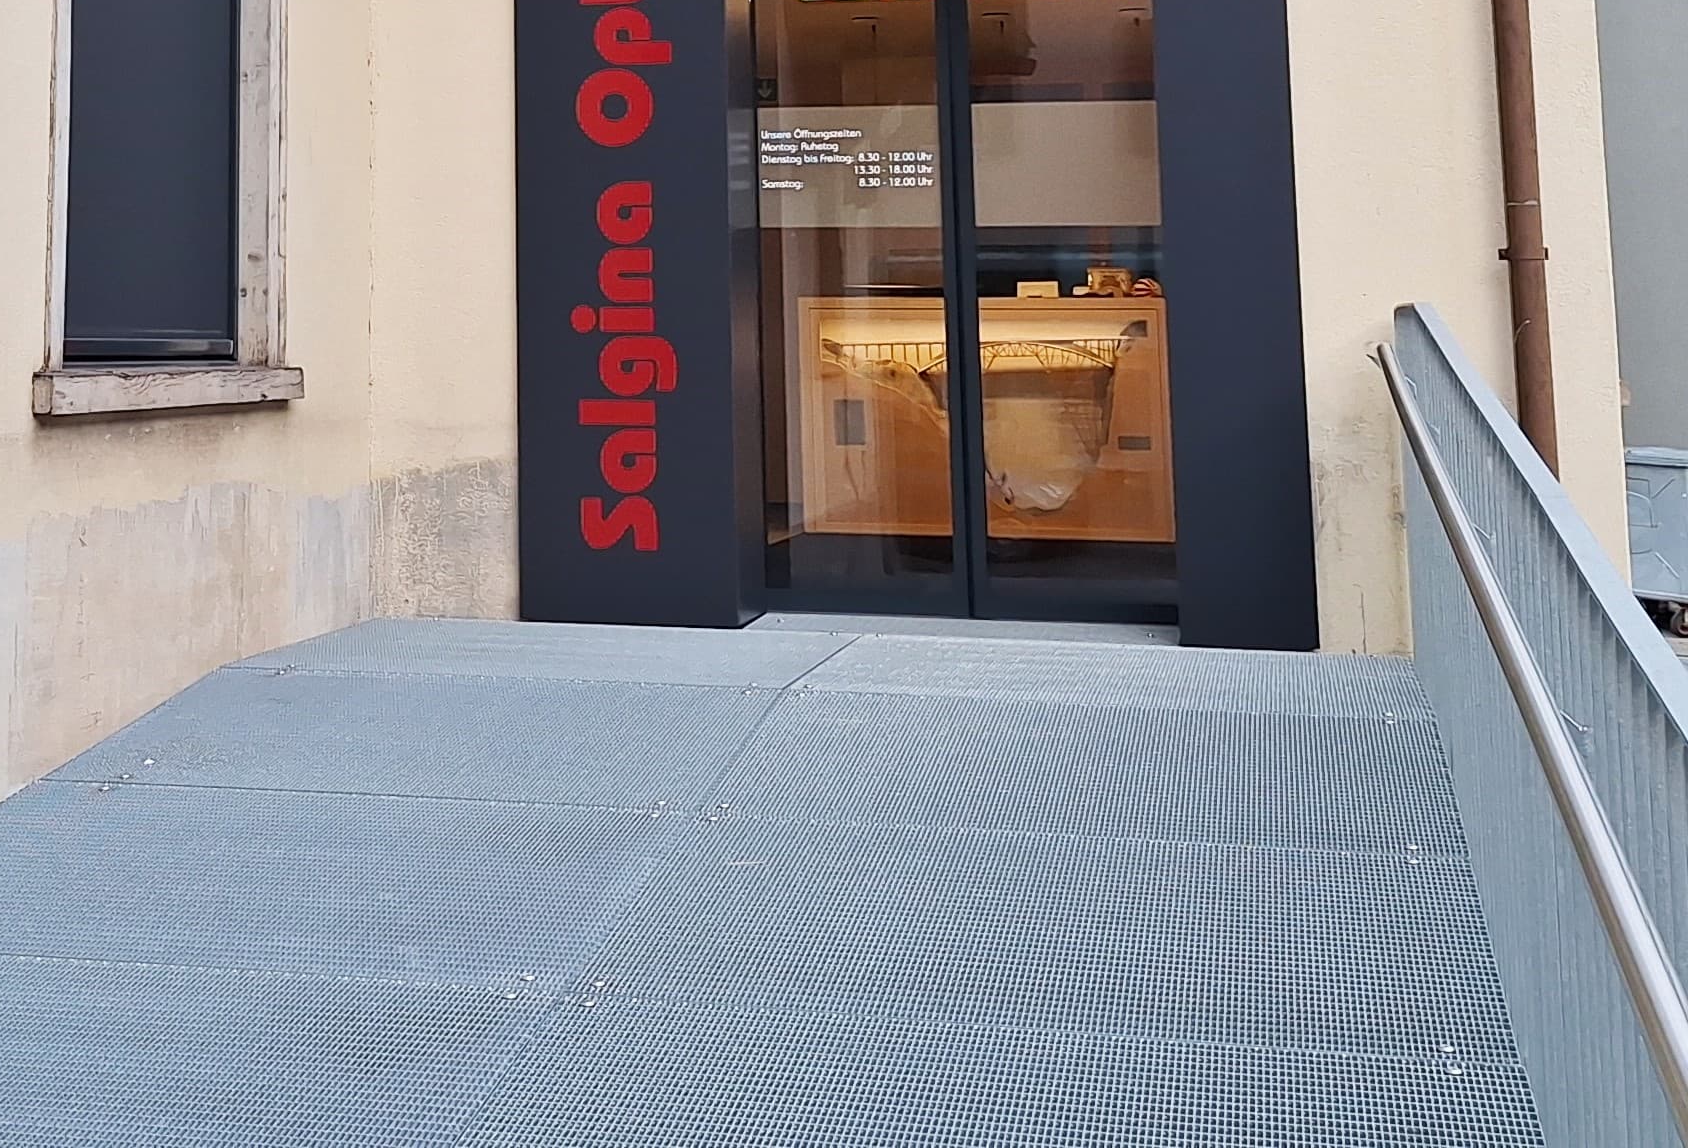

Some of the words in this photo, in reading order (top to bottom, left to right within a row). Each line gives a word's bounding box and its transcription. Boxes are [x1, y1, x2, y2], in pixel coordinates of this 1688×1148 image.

[761, 130, 792, 139] Unsere
[794, 128, 861, 140] Öffnungszeiten
[761, 143, 798, 153] Montag:
[801, 142, 839, 152] Ruhetag
[761, 155, 802, 165] Dienstag
[804, 154, 817, 163] bis
[820, 154, 855, 164] Freitag:
[858, 153, 880, 162] 8.30
[888, 152, 915, 161] 12.00
[916, 152, 933, 161] Uhr
[889, 165, 915, 174] 18.00
[917, 165, 933, 174] Uhr
[762, 179, 804, 189] Samstag:
[858, 178, 880, 187] 8.30
[889, 178, 915, 186] 12.00
[917, 177, 934, 186] Uhr
[570, 180, 679, 551] Salgina
